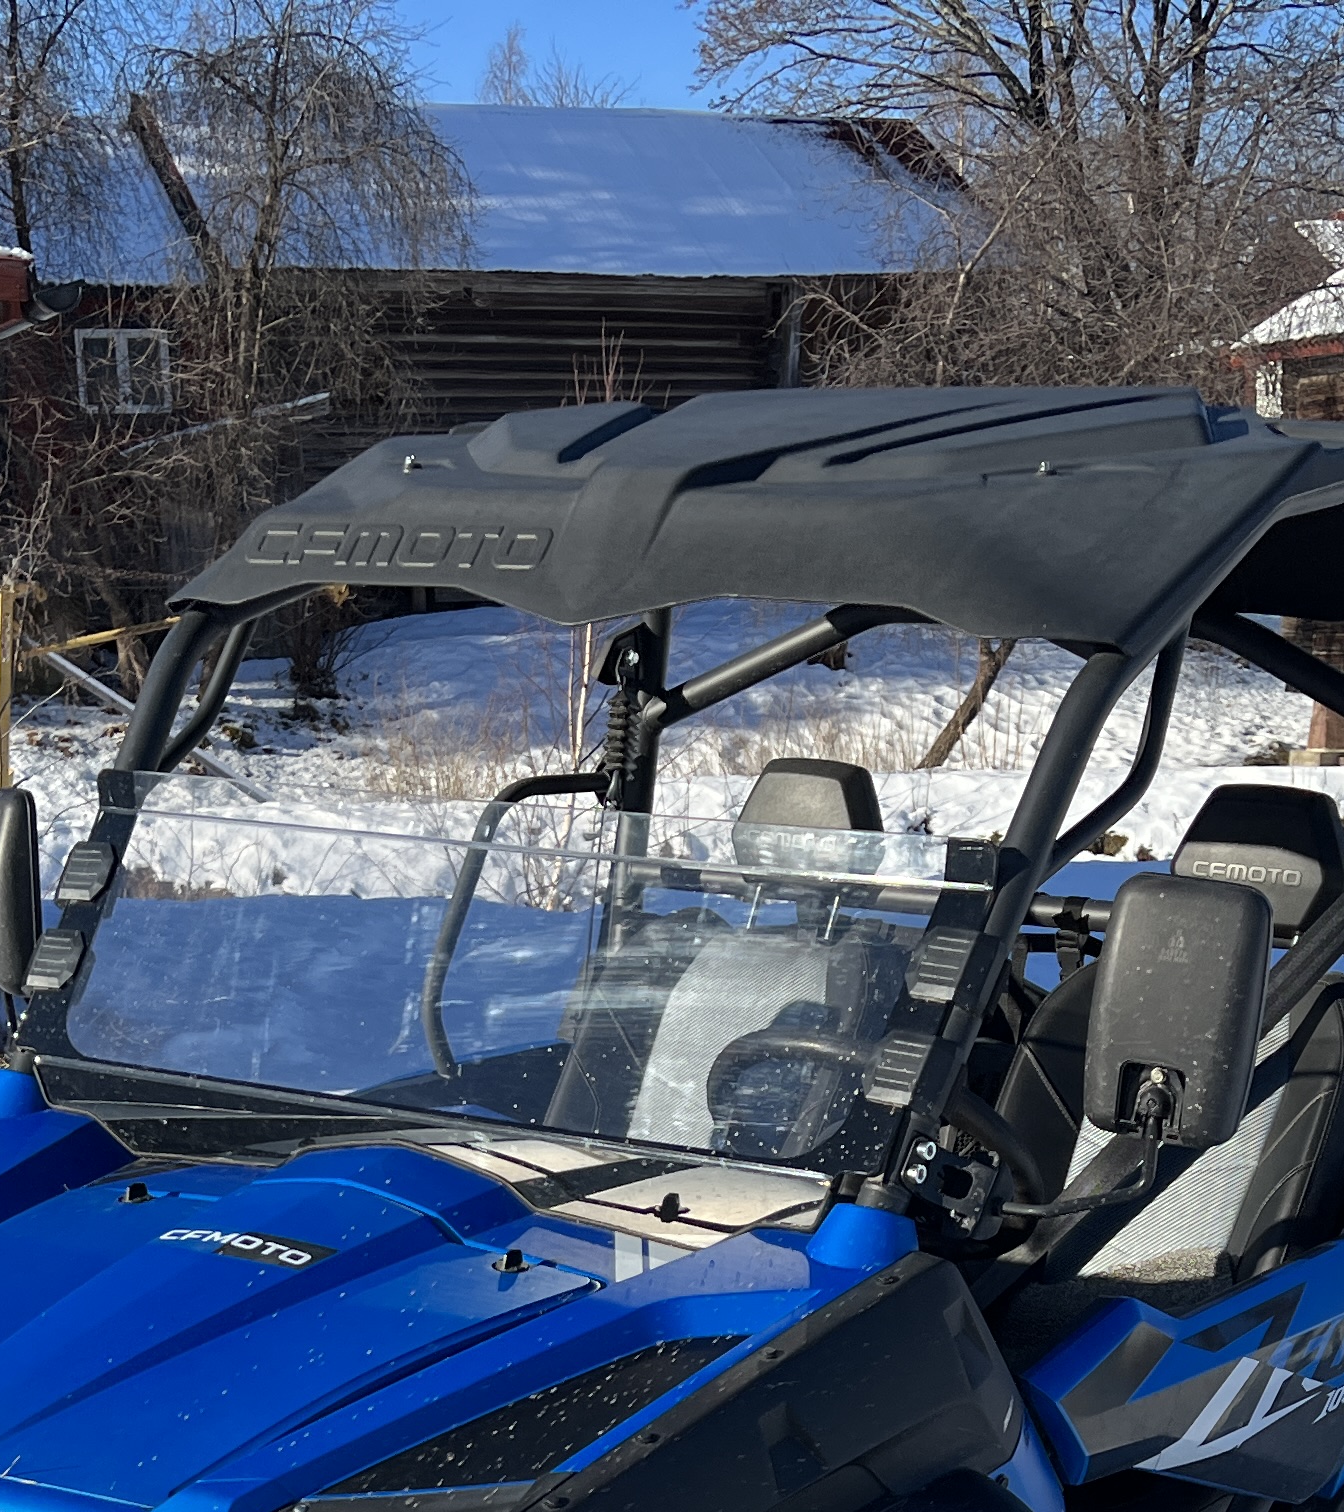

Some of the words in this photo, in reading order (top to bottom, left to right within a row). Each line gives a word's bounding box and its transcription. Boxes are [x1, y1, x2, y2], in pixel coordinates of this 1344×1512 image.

[245, 523, 554, 570] CFMOTO
[1192, 860, 1302, 887] CFMOTO
[159, 1229, 312, 1266] CFMOTO
